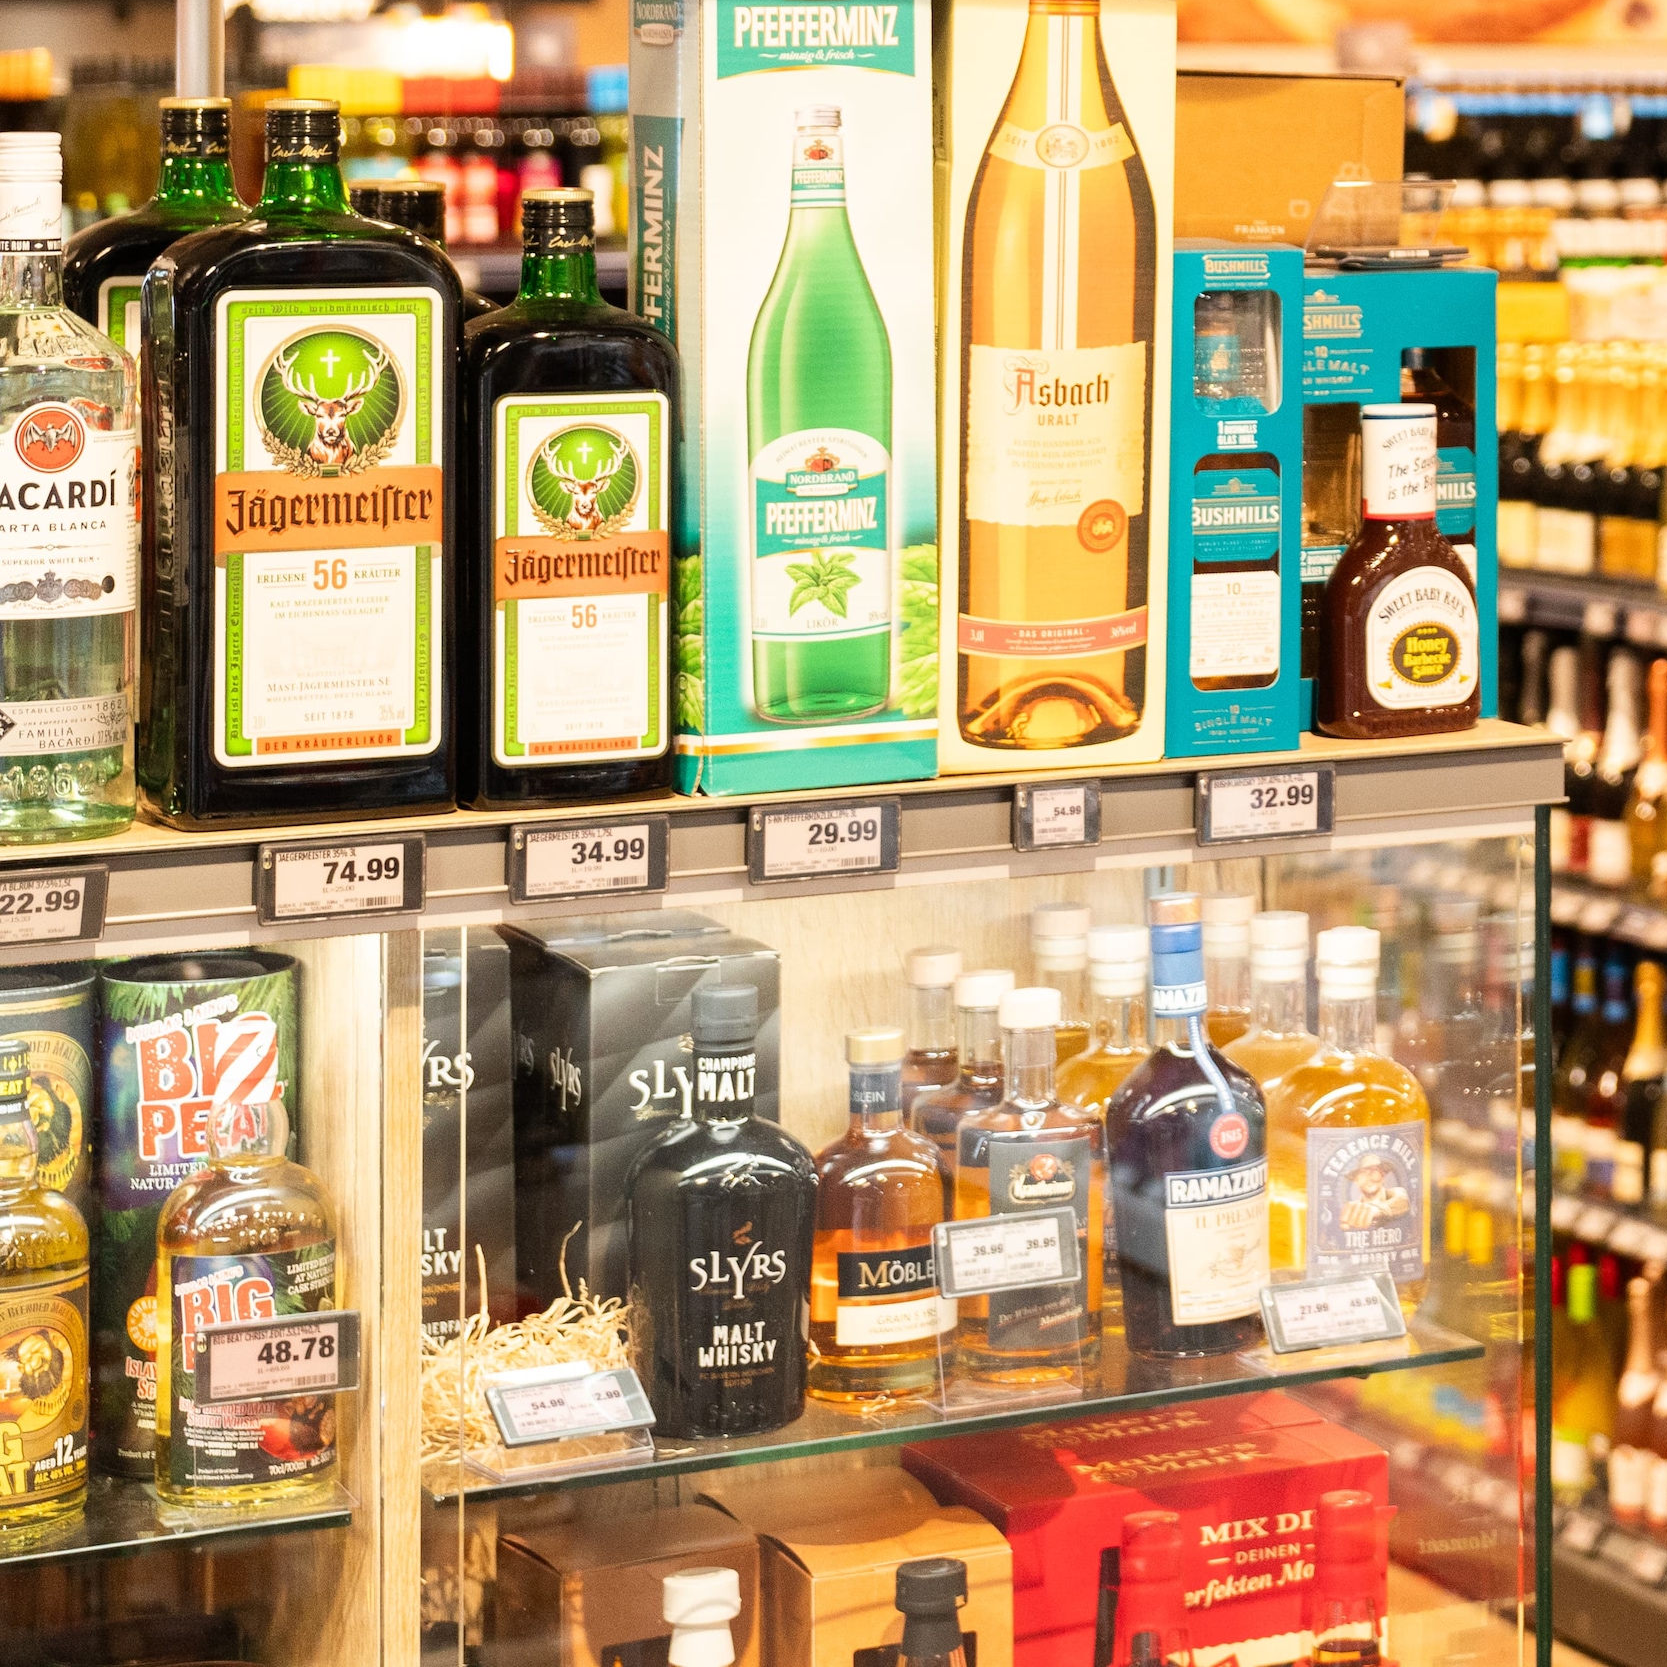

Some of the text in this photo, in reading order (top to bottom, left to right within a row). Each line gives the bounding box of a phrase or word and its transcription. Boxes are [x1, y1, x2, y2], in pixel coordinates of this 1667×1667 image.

[734, 5, 899, 48] PFEFFERMINZ
[825, 48, 855, 62] frisch
[644, 145, 663, 326] FERMINZ
[1234, 224, 1285, 235] FRANKEN
[10, 240, 30, 251] RUM
[1204, 258, 1269, 274] BUSHMILLS
[1303, 313, 1361, 331] SHMILLS
[1328, 359, 1370, 375] MALT
[1014, 368, 1110, 410] Asbach
[1037, 413, 1079, 427] URALT
[1388, 455, 1437, 480] The Sauc
[790, 470, 855, 485] NORDBRAND
[0, 468, 116, 511] ACARDÍ
[1387, 483, 1420, 501] is the
[1437, 481, 1477, 500] MILLS
[226, 483, 434, 536] Jägermeister
[766, 497, 877, 535] PFEFFERMINZ
[1192, 504, 1280, 527] BUSHMILLS
[0, 520, 107, 533] ARTA BLANCA
[2, 558, 45, 566] SUPERIOR
[49, 557, 75, 565] WHITE
[504, 546, 661, 587] Jägermeister
[257, 558, 401, 590] ERLESENE 56 KRÄUTER
[1226, 582, 1241, 596] 10
[356, 595, 390, 605] ELIXIER
[1378, 592, 1414, 625] SWEET
[1415, 587, 1442, 603] BABY
[571, 604, 597, 629] 56
[806, 616, 839, 629] LIKÖR
[1019, 629, 1084, 638] DAS ORIGINAL
[1405, 635, 1450, 655] Honey
[1402, 651, 1452, 667] Barbecue
[1411, 663, 1444, 680] Sauce
[12, 705, 78, 715] ESTABLECIDO
[95, 699, 122, 712] 1862
[304, 711, 354, 722] SEIT 1878
[1194, 714, 1273, 732] SINGLE MALT
[18, 727, 74, 739] FAMILIA
[264, 734, 394, 751] DER KRÄUTERLIKÖR
[535, 739, 633, 754] DER KRÄUTERLIKÖR
[1250, 784, 1314, 810] 32.99
[1054, 805, 1082, 816] 54.99
[529, 830, 580, 843] JAEGERMEISTER
[808, 819, 878, 846] 29.99
[278, 850, 331, 863] JAEGERMEISTER
[571, 837, 645, 865] 34.99
[323, 856, 400, 884] 74.99
[0, 889, 80, 915] 22.99
[0, 1079, 23, 1096] EAT
[698, 1068, 756, 1102] MALT
[1220, 1128, 1243, 1144] 1815
[1323, 1134, 1391, 1179] TERENCE
[423, 1227, 448, 1253] LT
[1345, 1230, 1371, 1249] THE
[287, 1259, 318, 1275] LIMITED
[1351, 1250, 1398, 1266] WHISKY
[690, 1240, 787, 1300] SLYRS
[858, 1258, 936, 1289] MÖßLE
[181, 1277, 277, 1326] BIG
[713, 1321, 767, 1347] MALT
[257, 1335, 335, 1365] 48.78
[699, 1339, 777, 1369] WHISKY
[531, 1397, 565, 1412] 54.99
[186, 1414, 222, 1429] SCOTCH
[34, 1434, 75, 1473] AGED 12
[1071, 1441, 1258, 1475] Maker's
[1142, 1448, 1275, 1475] Mark
[1200, 1509, 1316, 1546] MIX DI
[1235, 1543, 1301, 1565] DEINEN
[1184, 1573, 1273, 1611] erfekten
